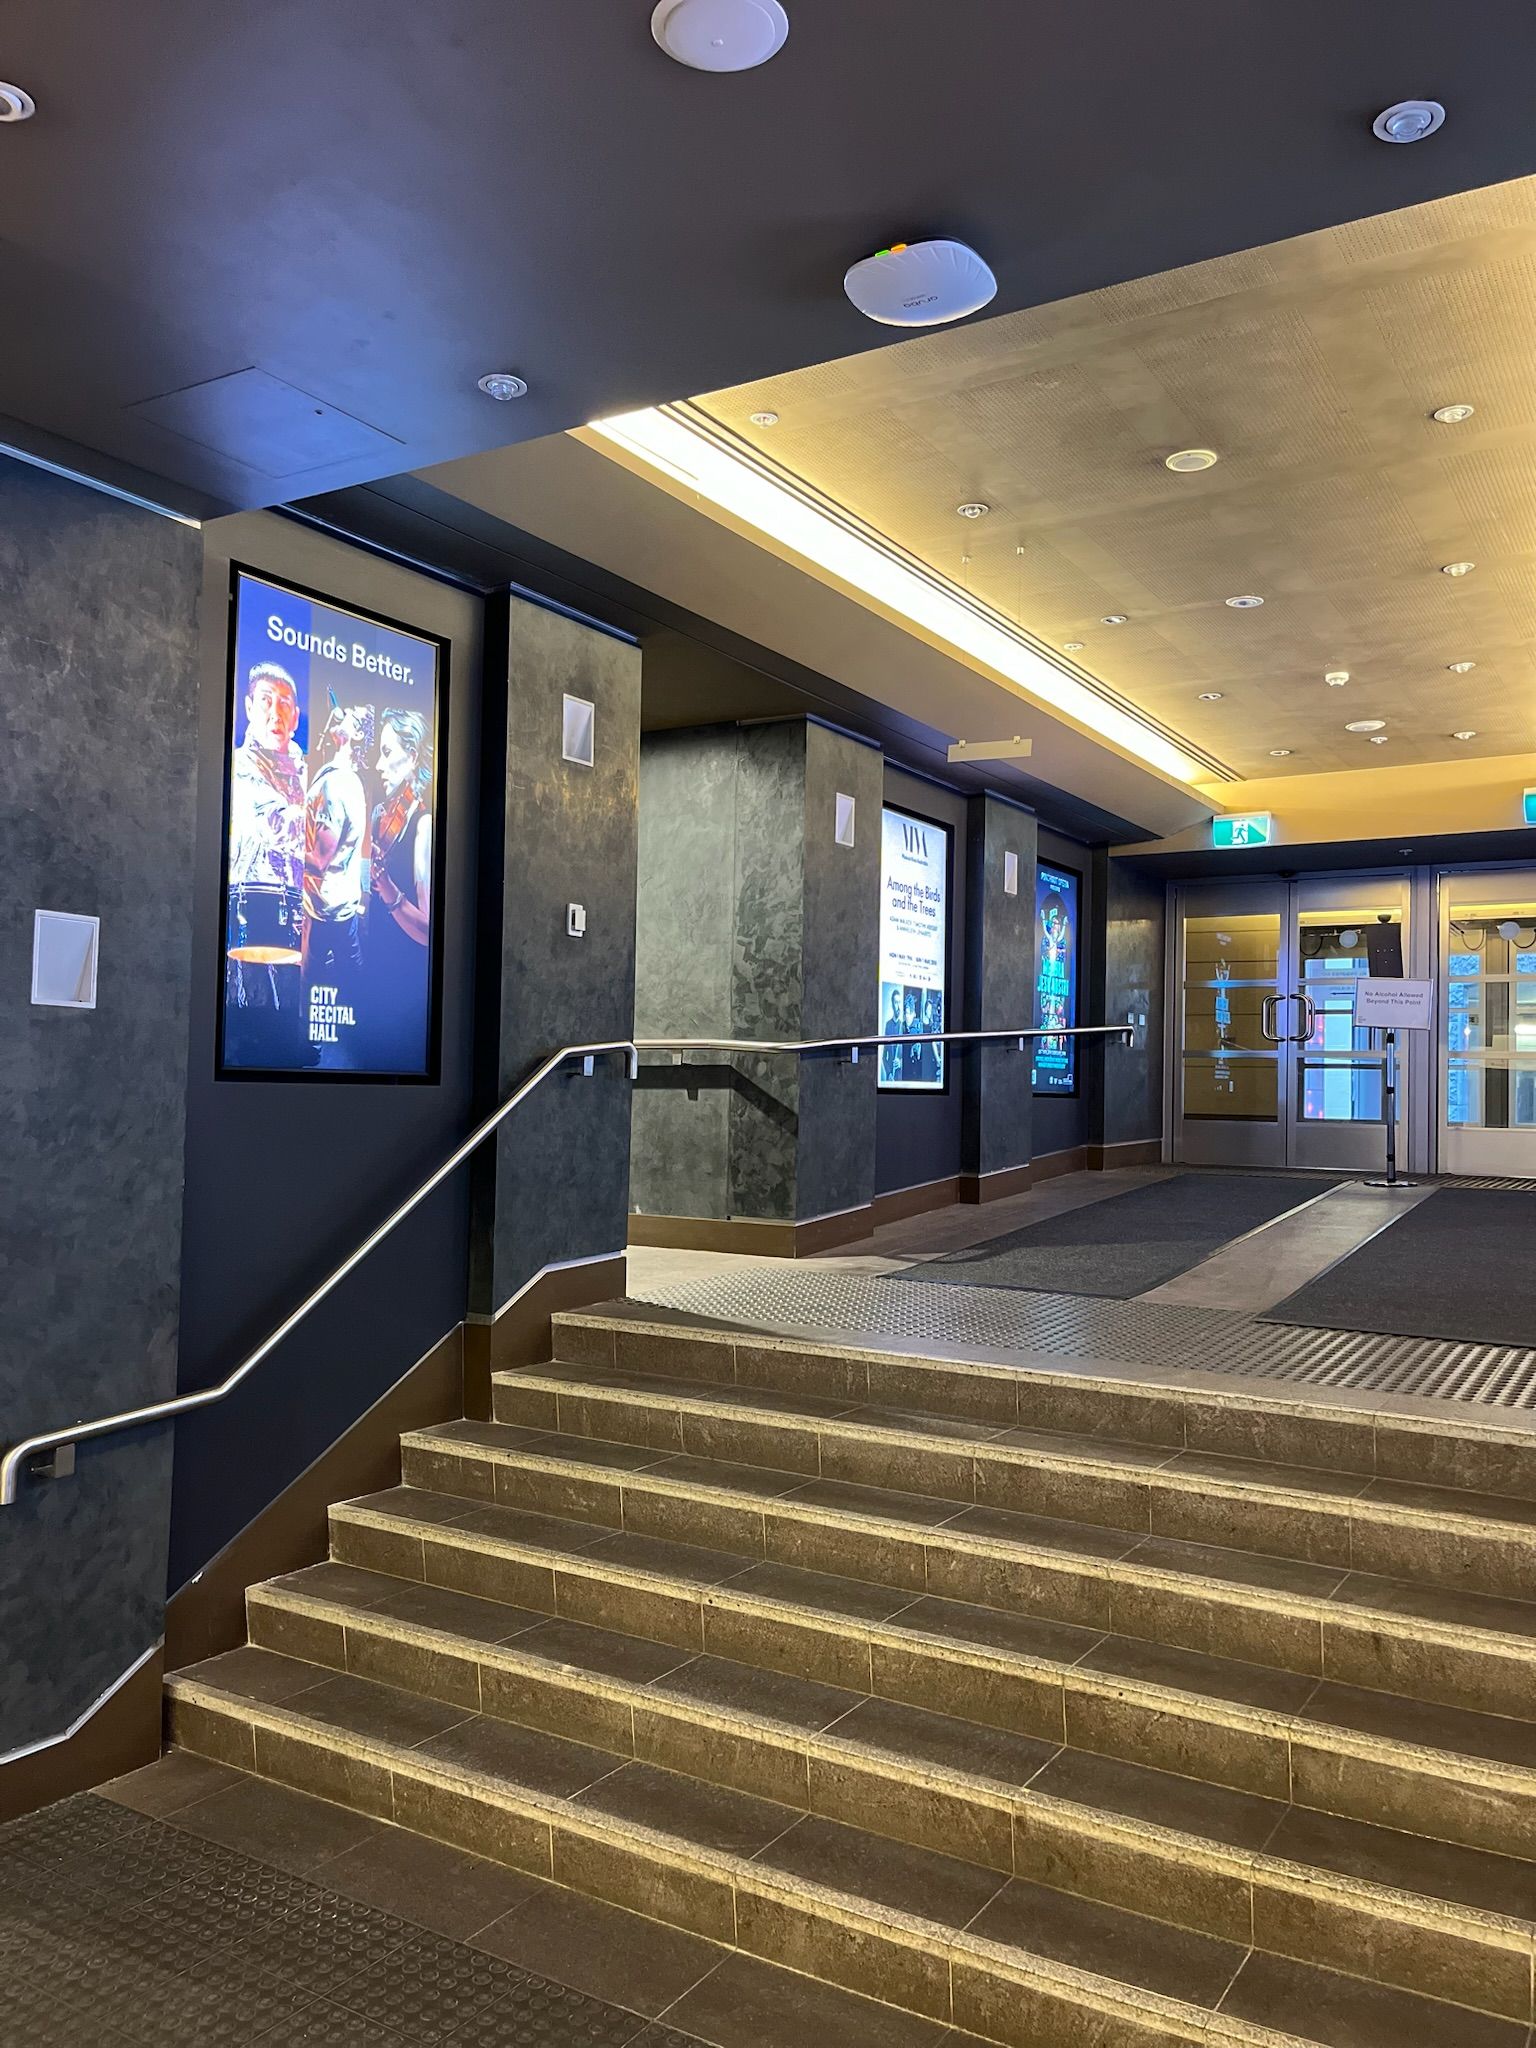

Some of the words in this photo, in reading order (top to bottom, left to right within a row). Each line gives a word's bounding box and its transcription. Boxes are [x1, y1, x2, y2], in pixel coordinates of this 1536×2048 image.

[266, 615, 348, 663] Sounds
[351, 643, 415, 686] Better.
[887, 875, 913, 900] Among
[913, 882, 924, 898] the
[925, 885, 941, 903] Birds
[892, 895, 906, 910] and
[907, 898, 918, 913] the
[919, 900, 936, 917] Trees
[310, 985, 338, 1006] CITY
[1366, 998, 1389, 1006] Beyond
[310, 1004, 356, 1026] RECITAL
[309, 1022, 339, 1042] HALL
